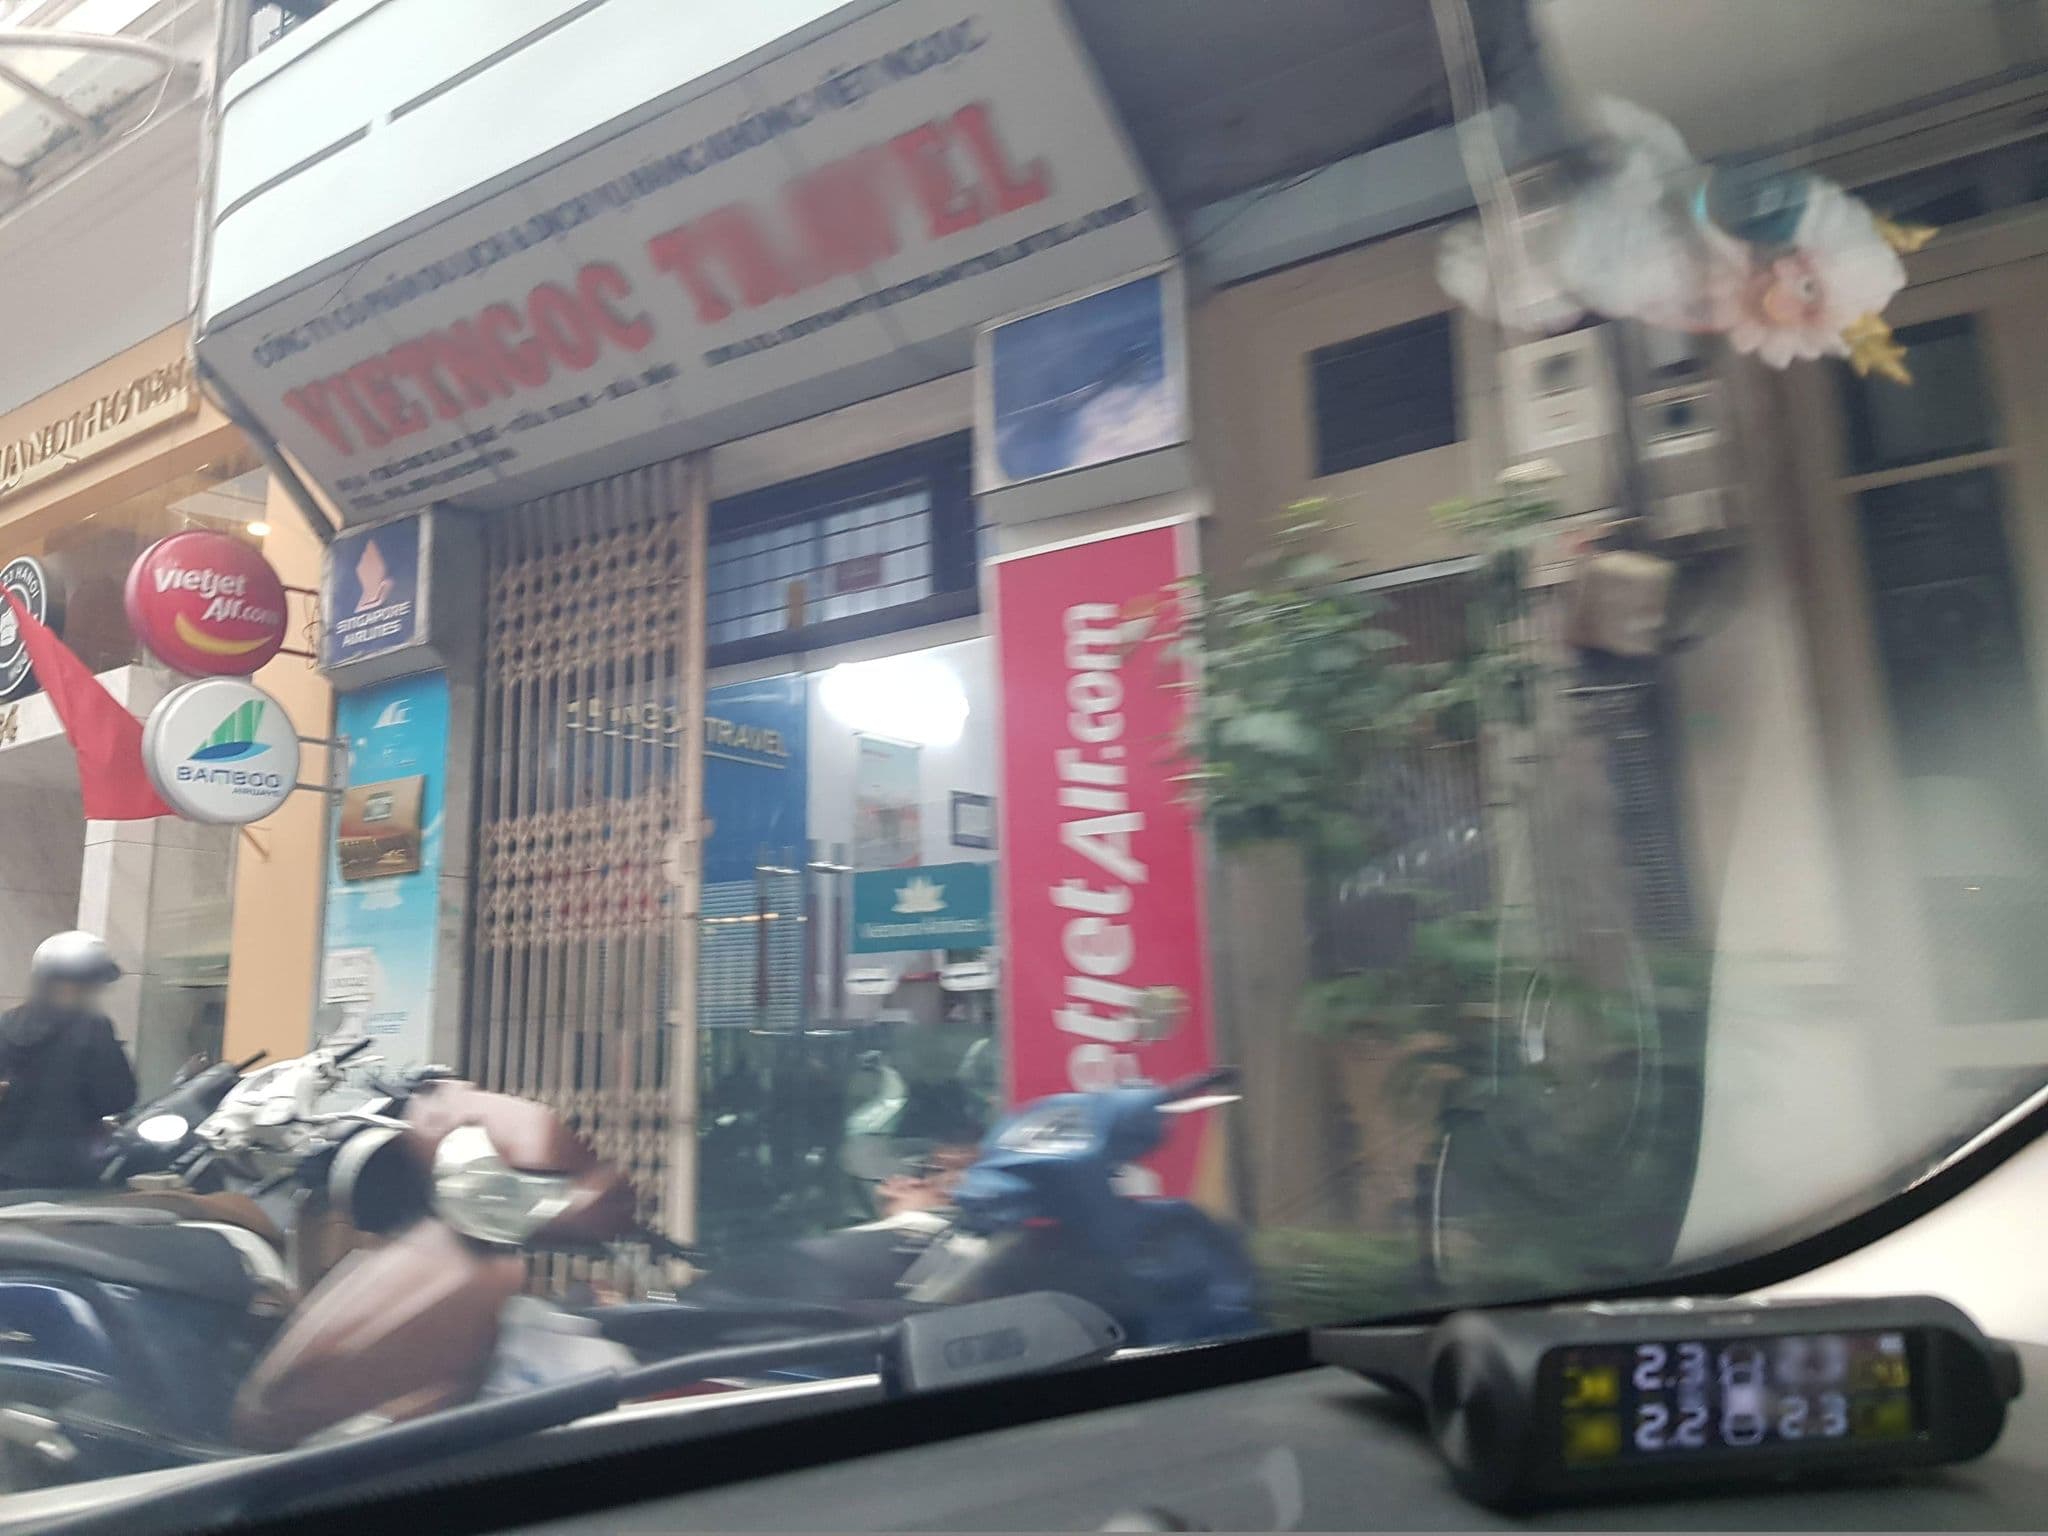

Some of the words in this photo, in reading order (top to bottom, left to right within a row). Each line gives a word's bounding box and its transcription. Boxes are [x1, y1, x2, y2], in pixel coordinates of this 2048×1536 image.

[15, 567, 40, 599] HANOI
[153, 567, 248, 600] Vietjet
[176, 766, 280, 788] BAMBOO
[1049, 601, 1162, 1197] etjetAir.com
